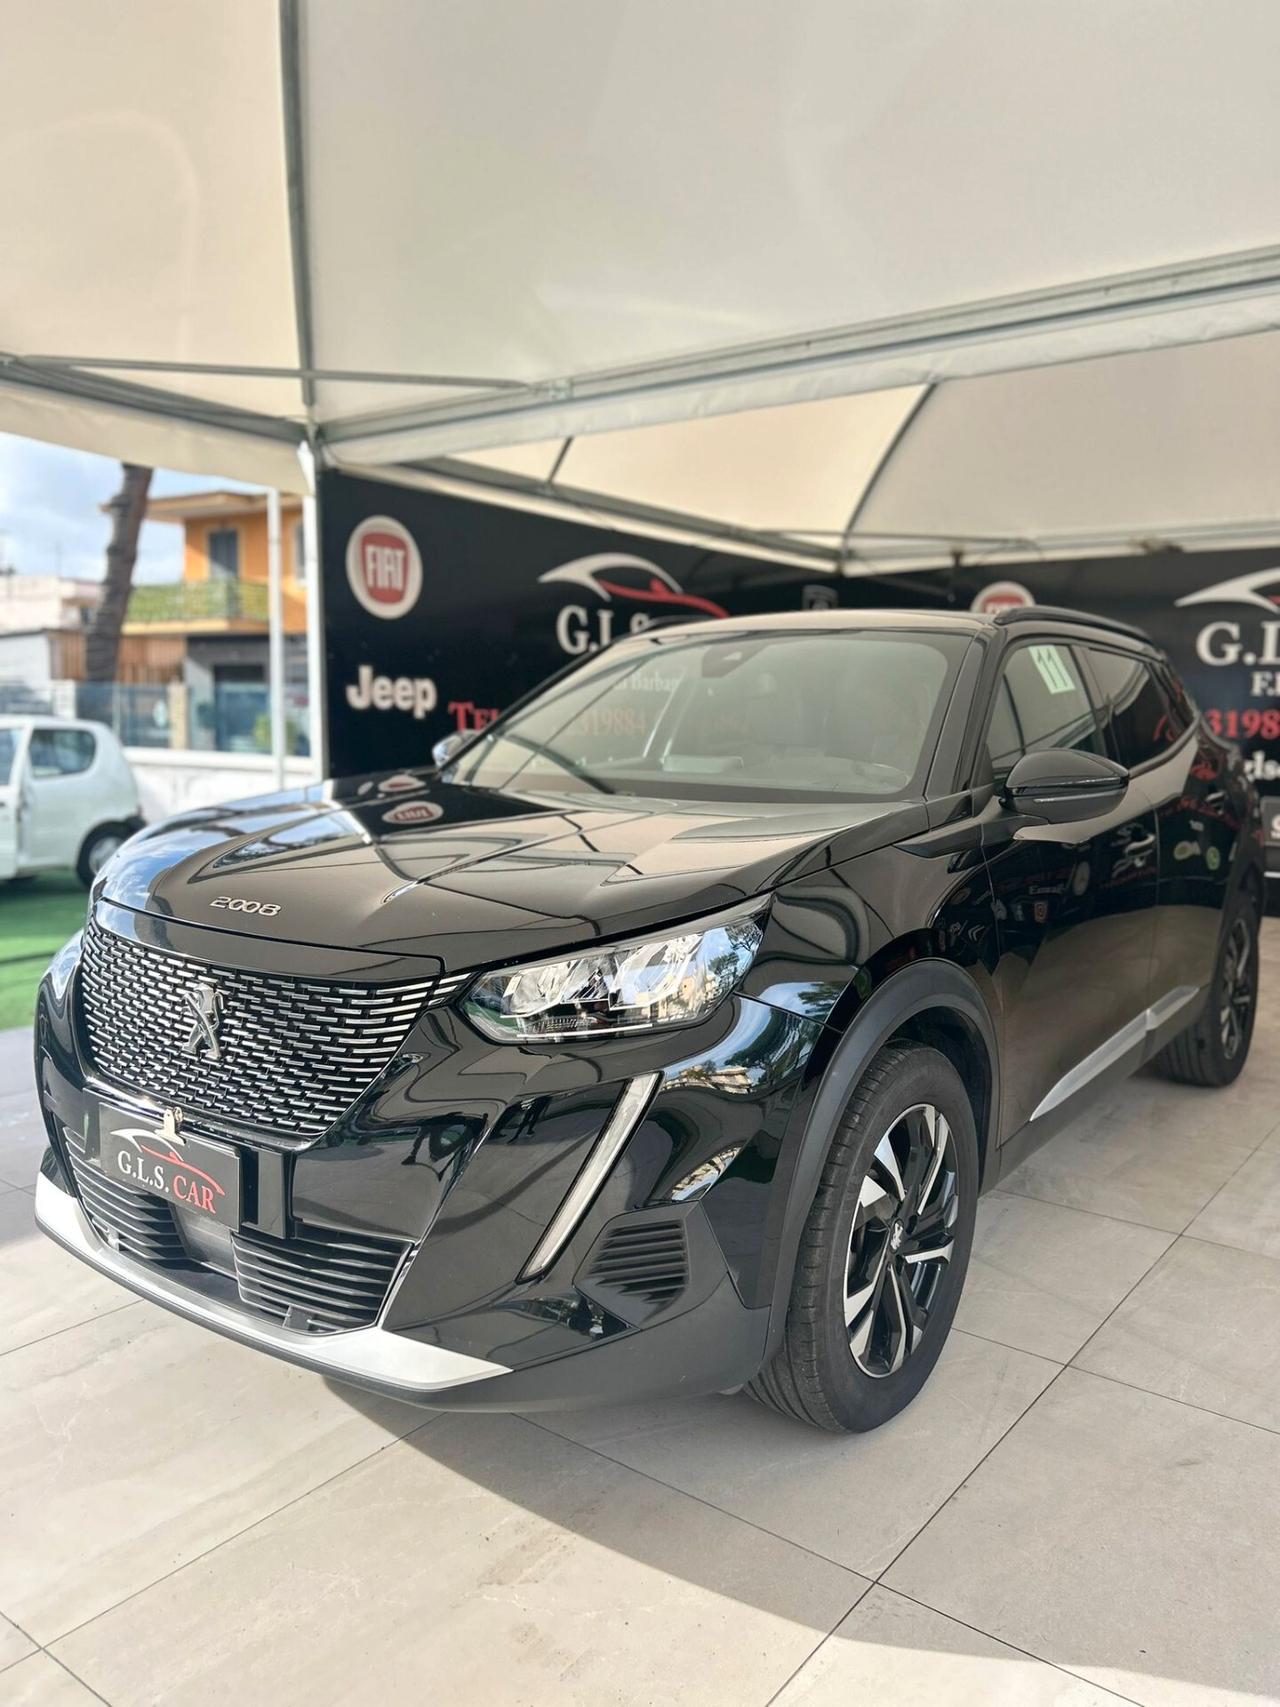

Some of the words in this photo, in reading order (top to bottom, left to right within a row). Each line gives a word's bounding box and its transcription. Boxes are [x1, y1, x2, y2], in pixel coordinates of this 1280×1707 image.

[365, 545, 406, 590] FIAT
[346, 664, 437, 719] Jeep
[209, 896, 282, 917] 2008
[117, 1150, 170, 1194] G.L.S.
[173, 1175, 217, 1215] CAR
